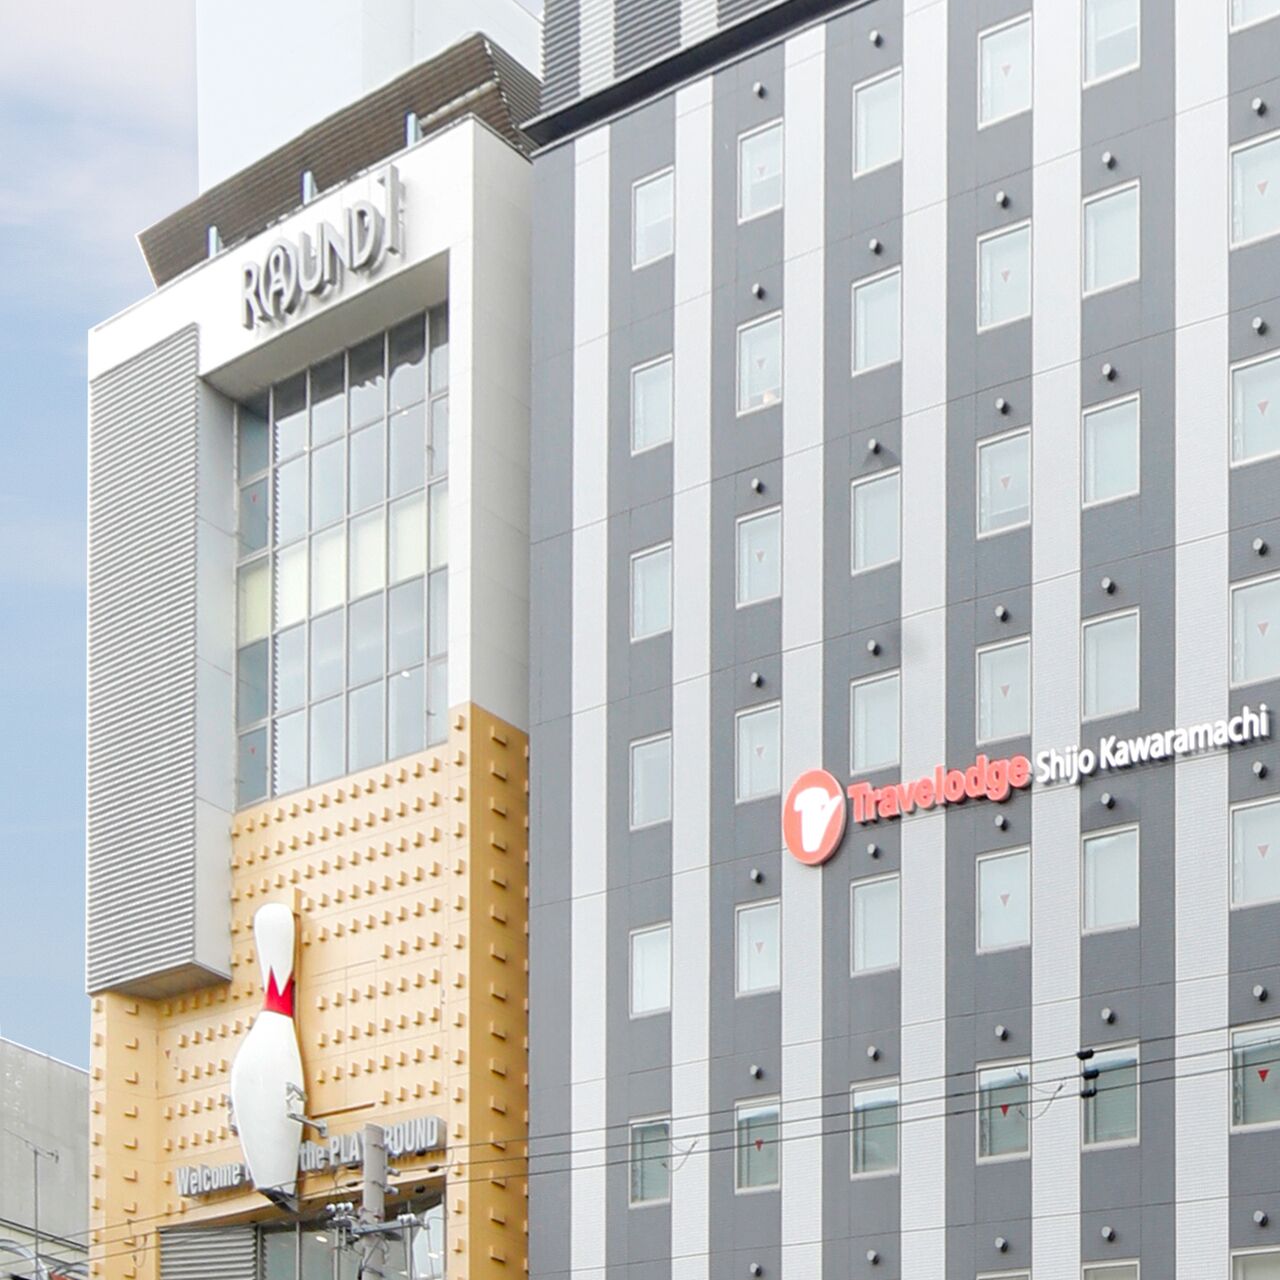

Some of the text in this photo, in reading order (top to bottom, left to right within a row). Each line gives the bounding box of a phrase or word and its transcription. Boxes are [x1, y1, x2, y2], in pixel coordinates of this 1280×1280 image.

[847, 703, 1269, 824] Travelodge Shijo Kawaramachi
[177, 1162, 242, 1196] Welcome
